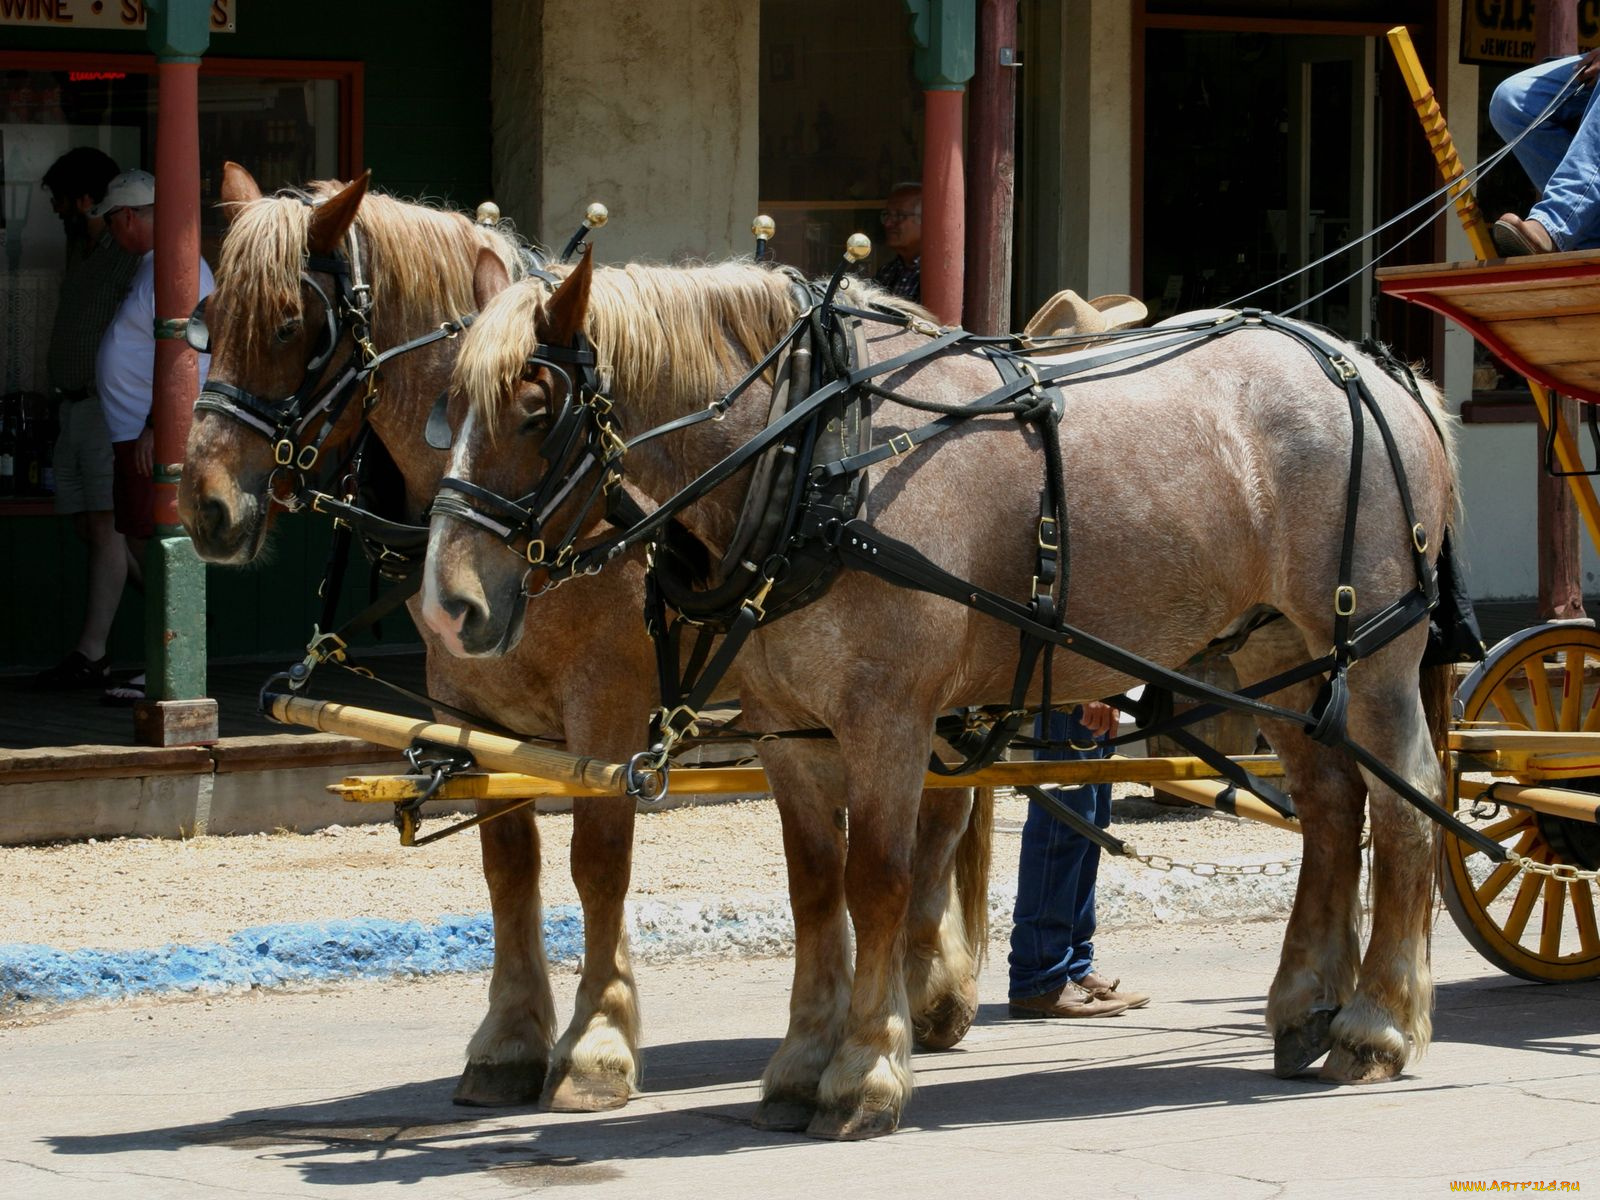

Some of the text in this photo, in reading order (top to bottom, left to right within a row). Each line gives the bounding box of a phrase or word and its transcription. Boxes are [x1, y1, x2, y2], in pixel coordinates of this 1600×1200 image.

[1, 0, 73, 21] WINE
[1476, 0, 1536, 29] GIF
[1481, 38, 1536, 59] JEWELRY
